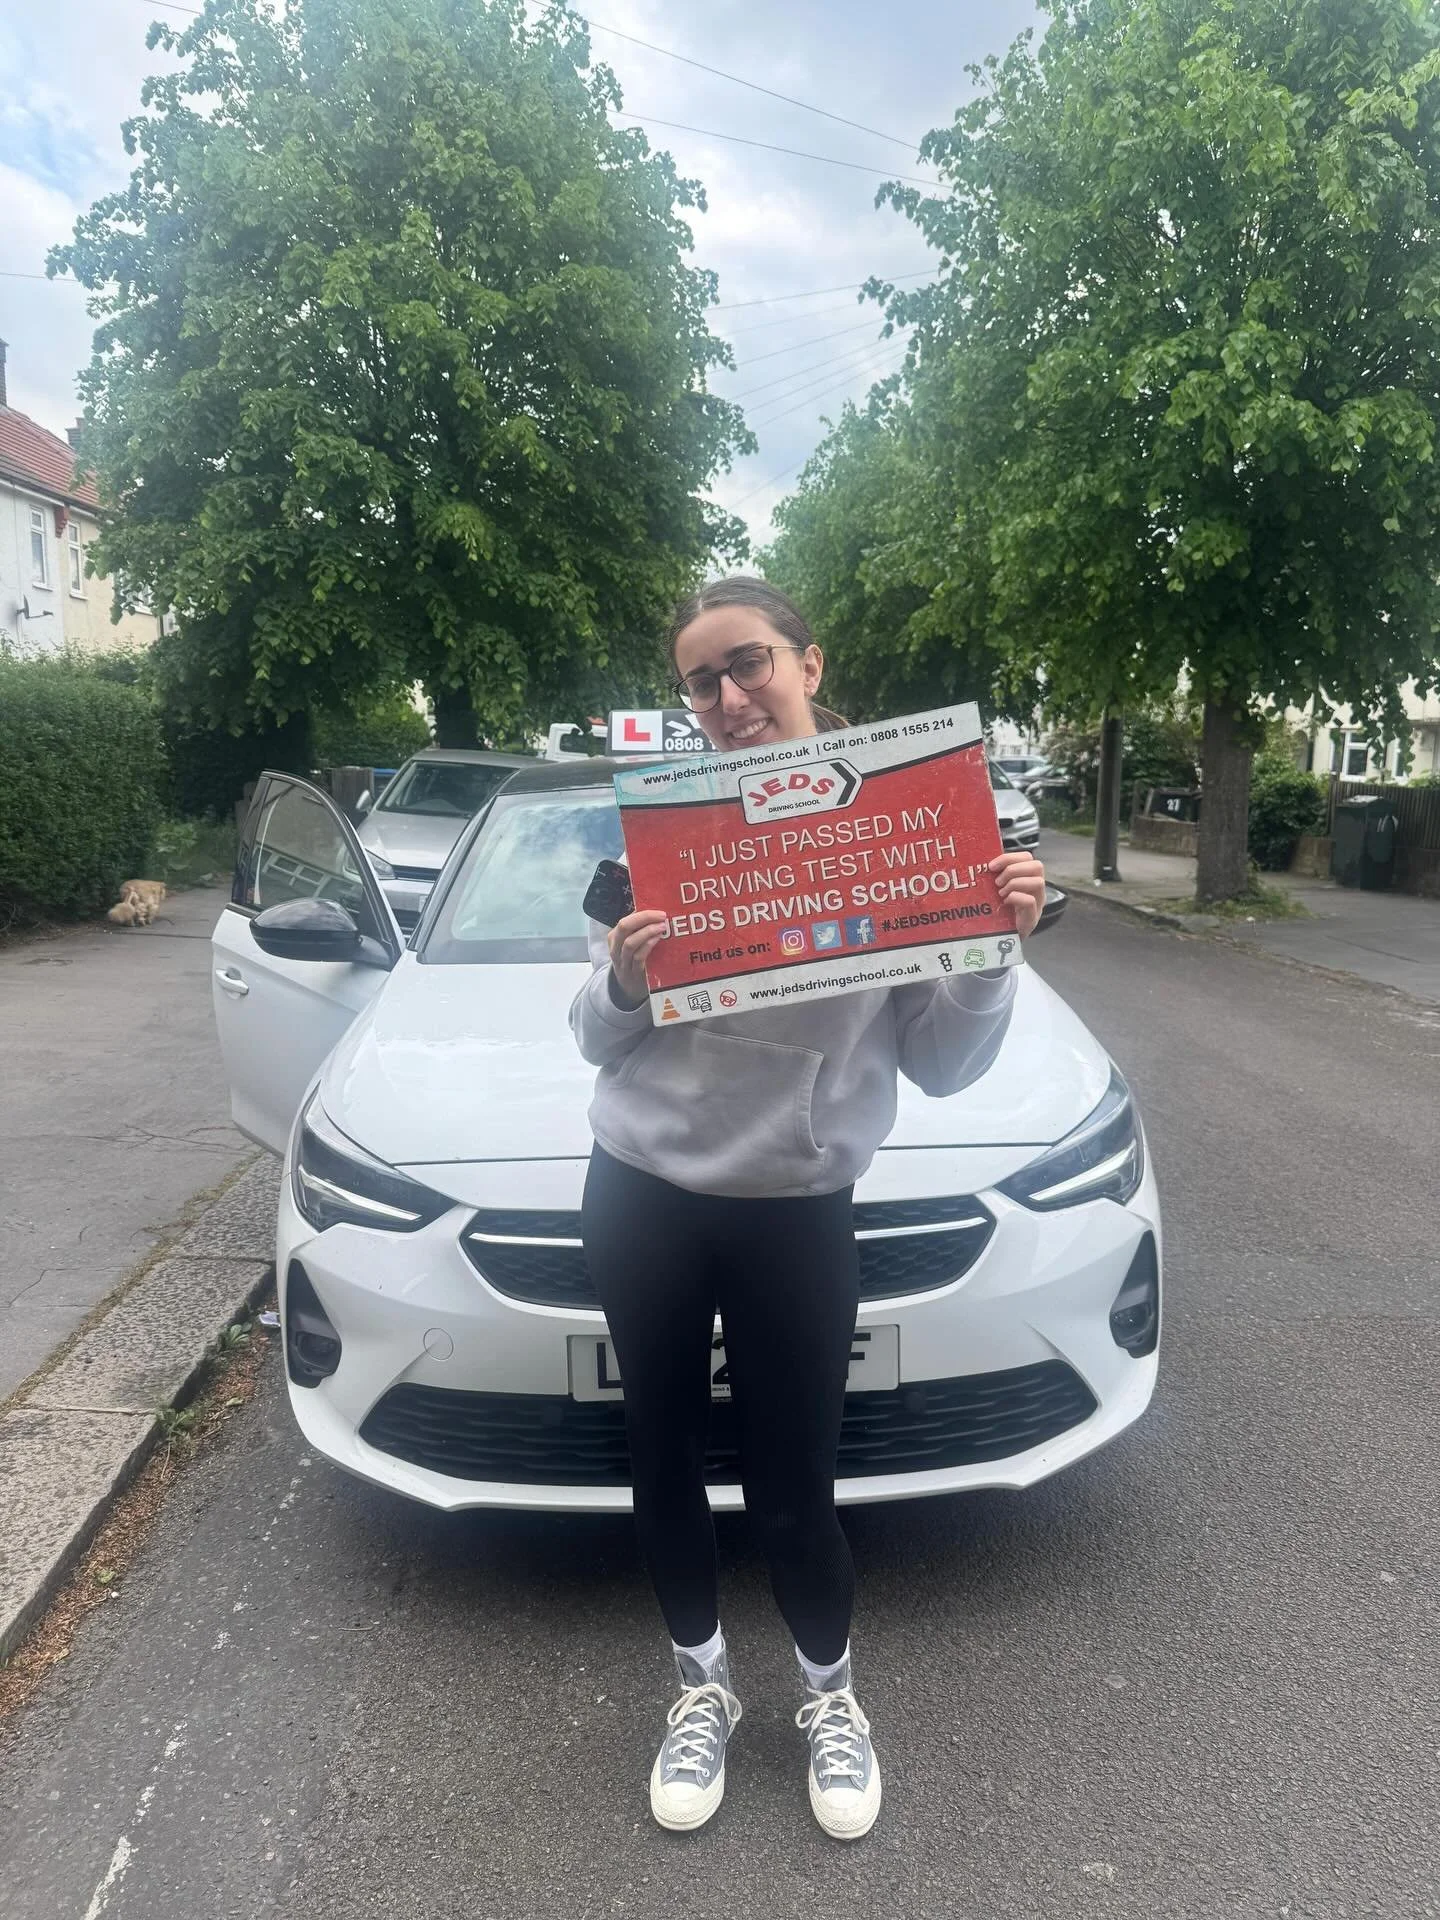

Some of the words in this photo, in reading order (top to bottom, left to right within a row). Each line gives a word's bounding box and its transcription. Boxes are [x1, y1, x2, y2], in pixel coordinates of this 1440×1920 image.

[624, 718, 651, 742] L
[643, 747, 810, 785] www.jedsdrivingschool.co.uk
[823, 739, 846, 753] Call
[849, 737, 868, 748] on:
[870, 728, 899, 744] 0808
[901, 723, 930, 737] 1555
[932, 717, 954, 731] 214
[664, 737, 704, 752] 0808
[747, 772, 835, 807] JEDS
[768, 802, 793, 814] DRIVING
[794, 799, 821, 808] SCHOOL
[705, 834, 773, 869] JUST
[781, 814, 893, 855] PASSED
[901, 803, 944, 833] MY
[680, 863, 797, 905] DRIVING
[801, 850, 875, 882] TEST
[881, 835, 957, 870] WITH
[660, 909, 726, 941] JEDS
[733, 889, 845, 928] DRIVING
[690, 947, 722, 965] Find
[725, 946, 744, 958] us
[747, 943, 771, 955] on:
[881, 902, 993, 933] #JEDSDRIVING
[750, 963, 922, 1001] www.jedsdrivingschool.co.uk
